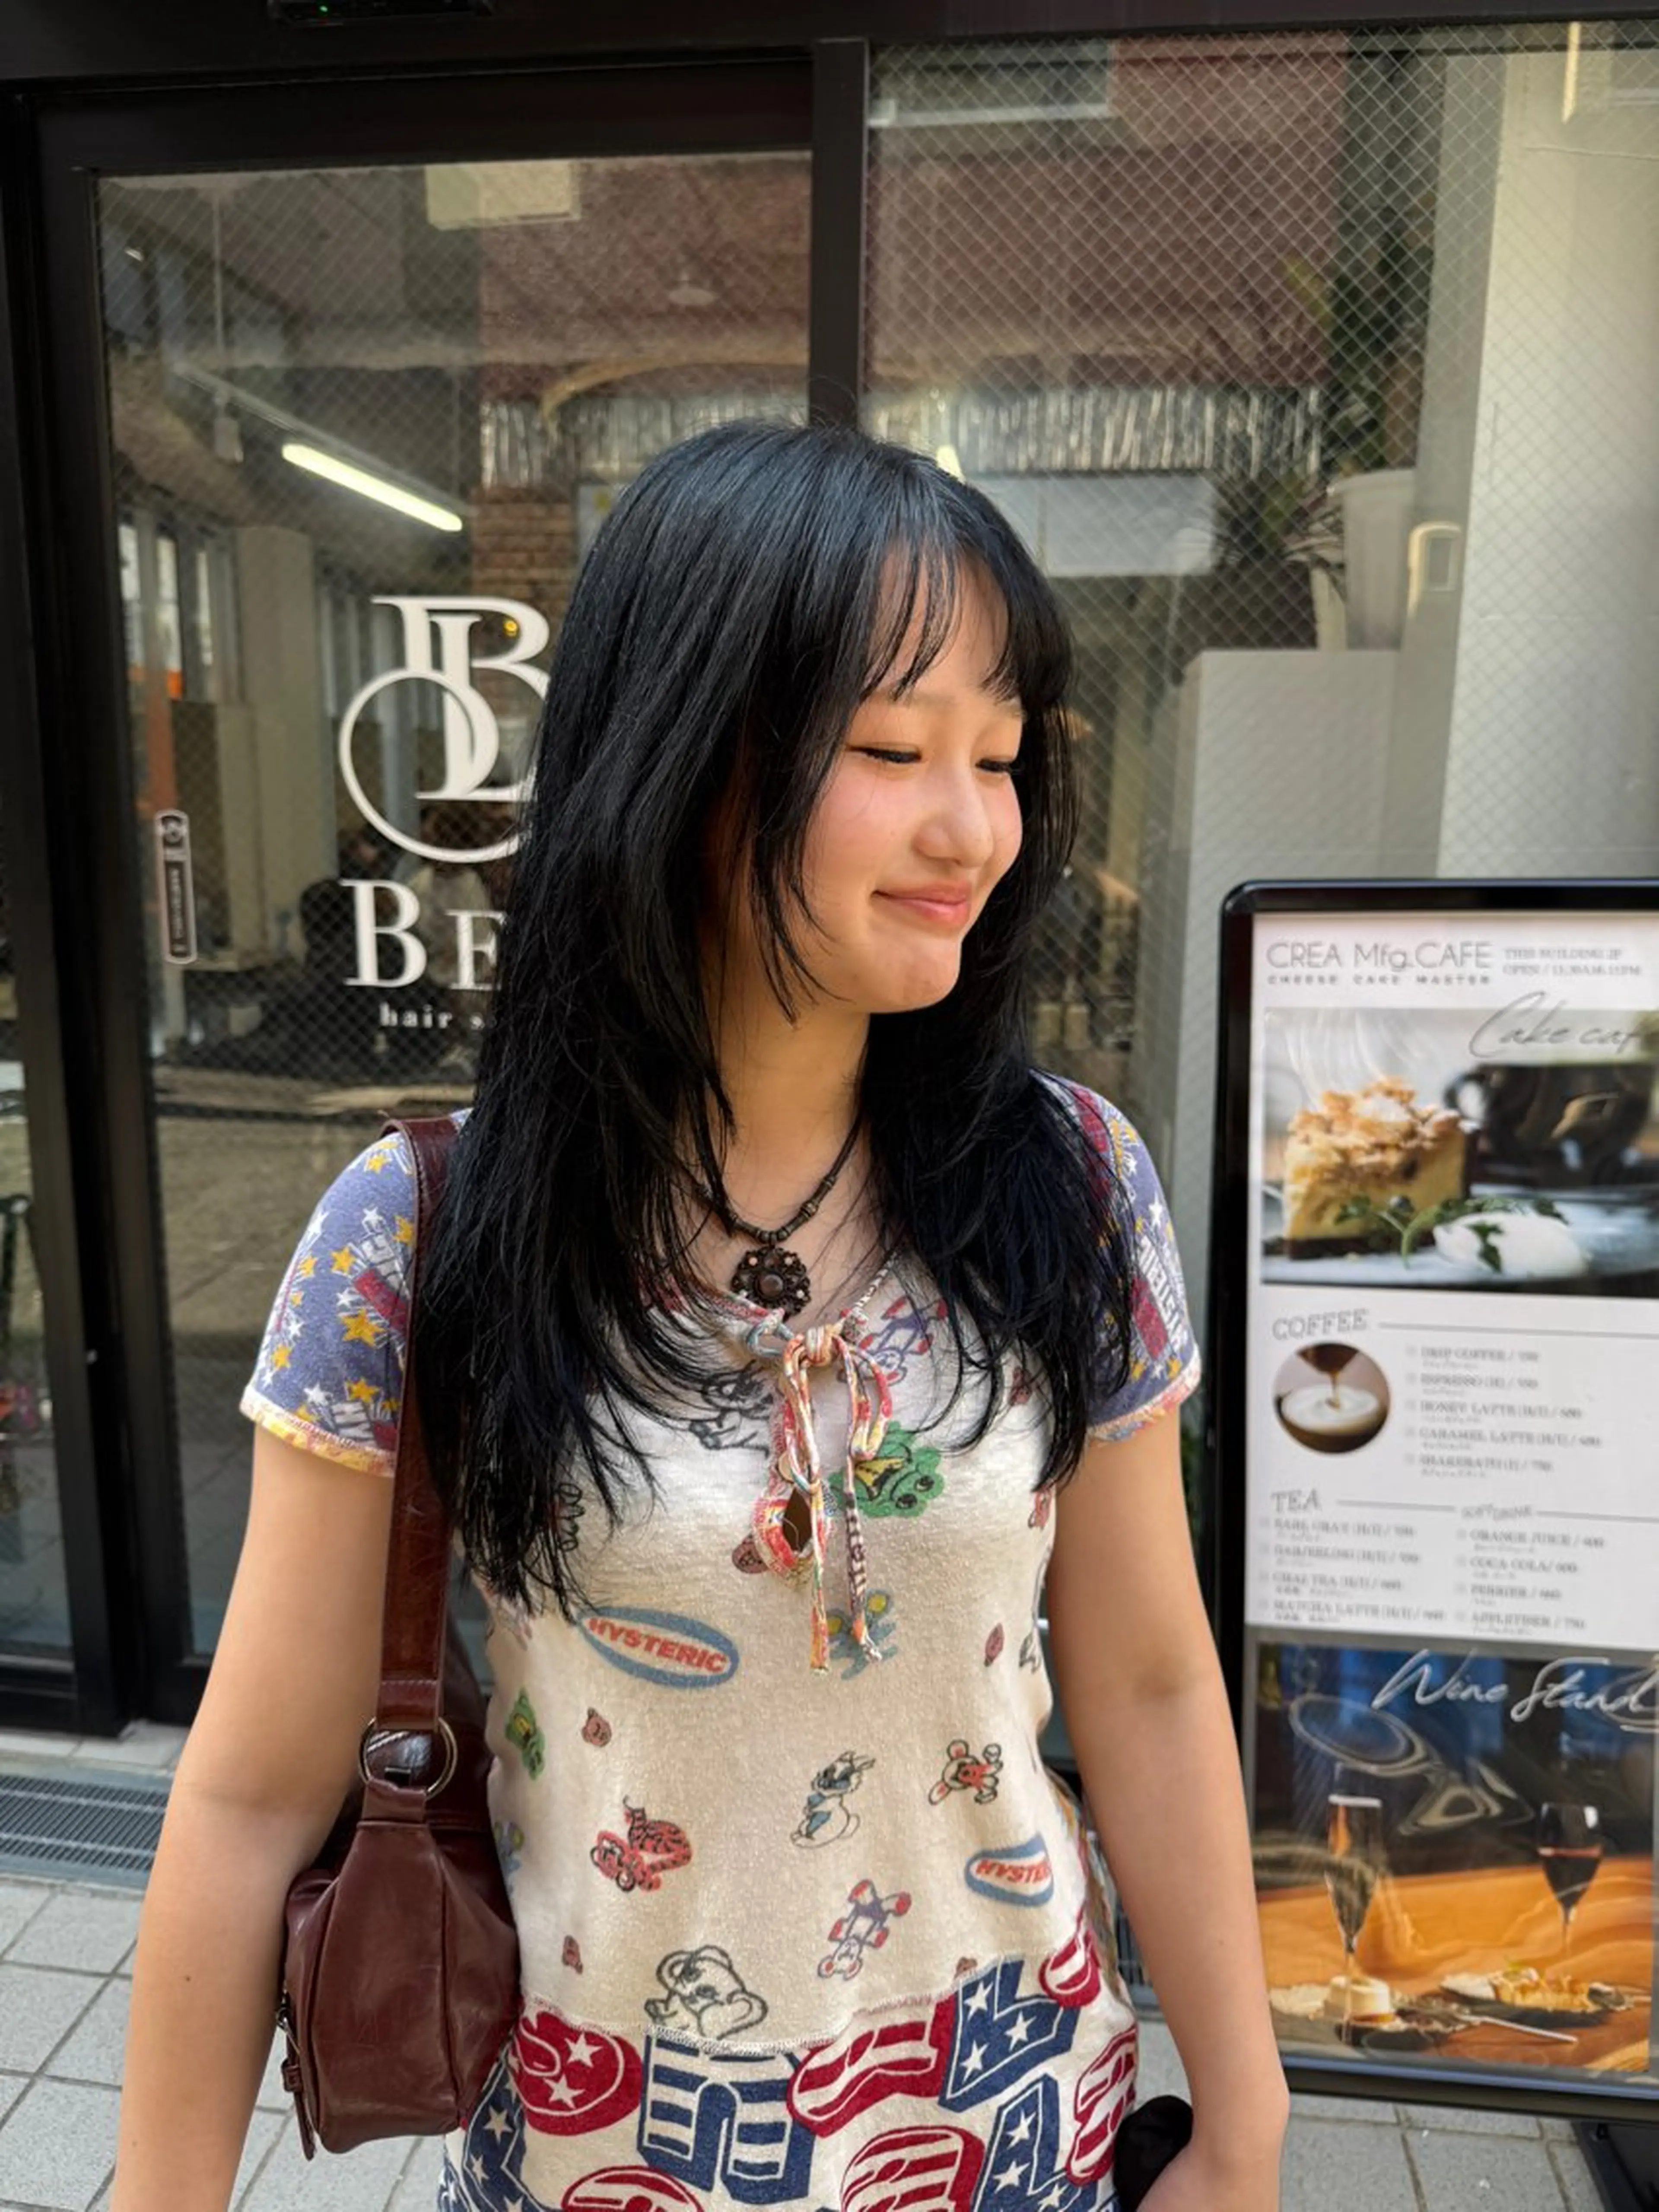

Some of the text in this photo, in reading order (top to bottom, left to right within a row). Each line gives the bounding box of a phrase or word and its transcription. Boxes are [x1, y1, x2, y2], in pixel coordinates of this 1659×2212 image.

[1265, 941, 1342, 969] CREA
[379, 1001, 452, 1029] hair
[1272, 1308, 1370, 1341] COFFEE
[1270, 1489, 1322, 1513] TEA
[588, 1617, 731, 1675] HYSTERIC
[1372, 1648, 1508, 1709] Wine
